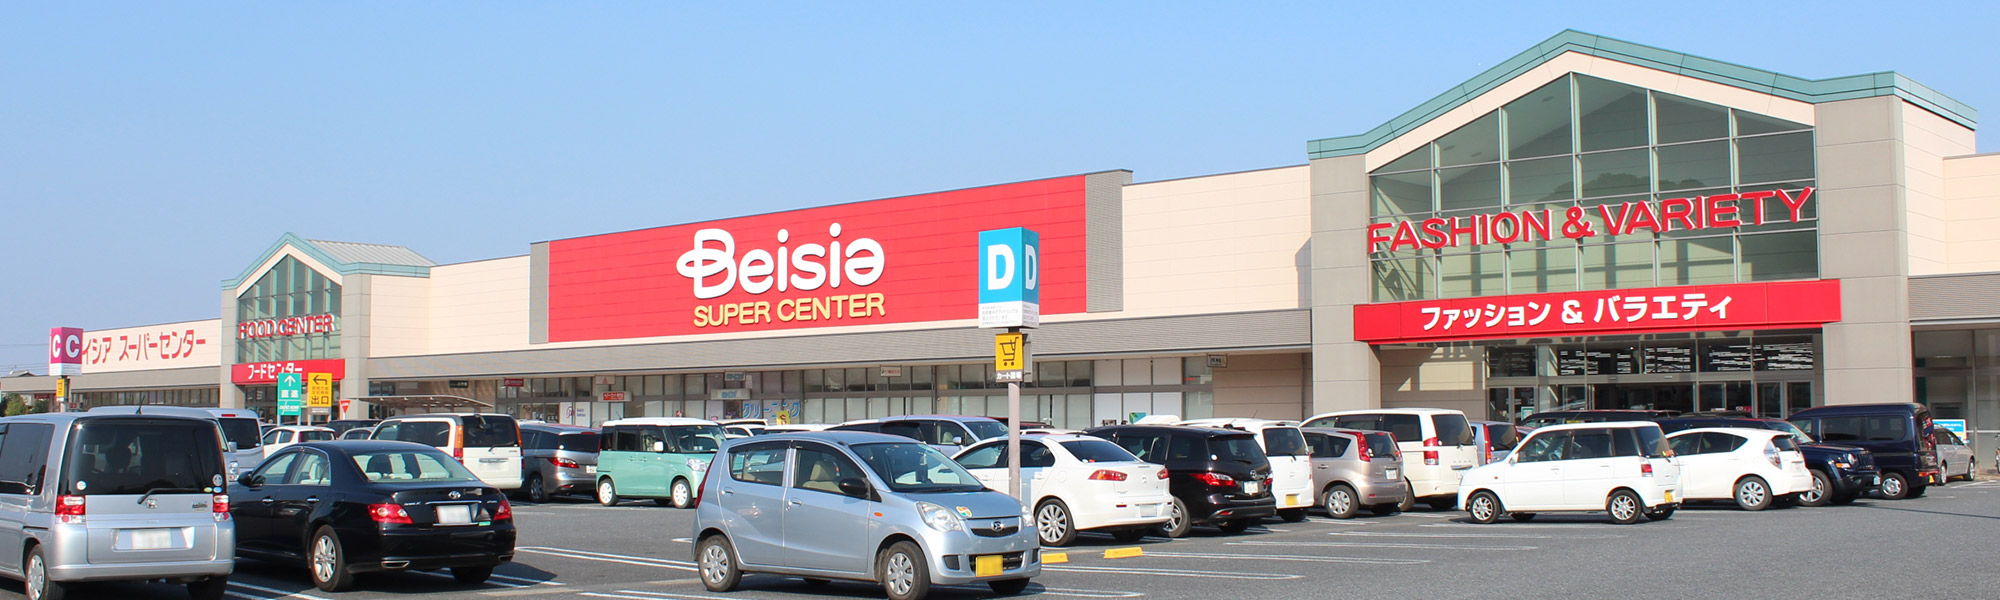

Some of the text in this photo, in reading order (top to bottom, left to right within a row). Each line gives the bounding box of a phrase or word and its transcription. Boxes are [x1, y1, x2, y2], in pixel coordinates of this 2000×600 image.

[1367, 187, 1817, 253] FASHION & VARIETY
[676, 222, 885, 299] Beisia
[987, 244, 1015, 290] D
[1025, 243, 1037, 290] D
[238, 313, 336, 340] FOOD CENTER
[693, 293, 886, 327] SUPER CENTER
[1421, 293, 1733, 331] ファッション & バラエティ
[52, 334, 61, 358] C
[66, 334, 80, 358] C
[119, 329, 206, 361] スーパーセンター
[311, 395, 329, 405] 出口
